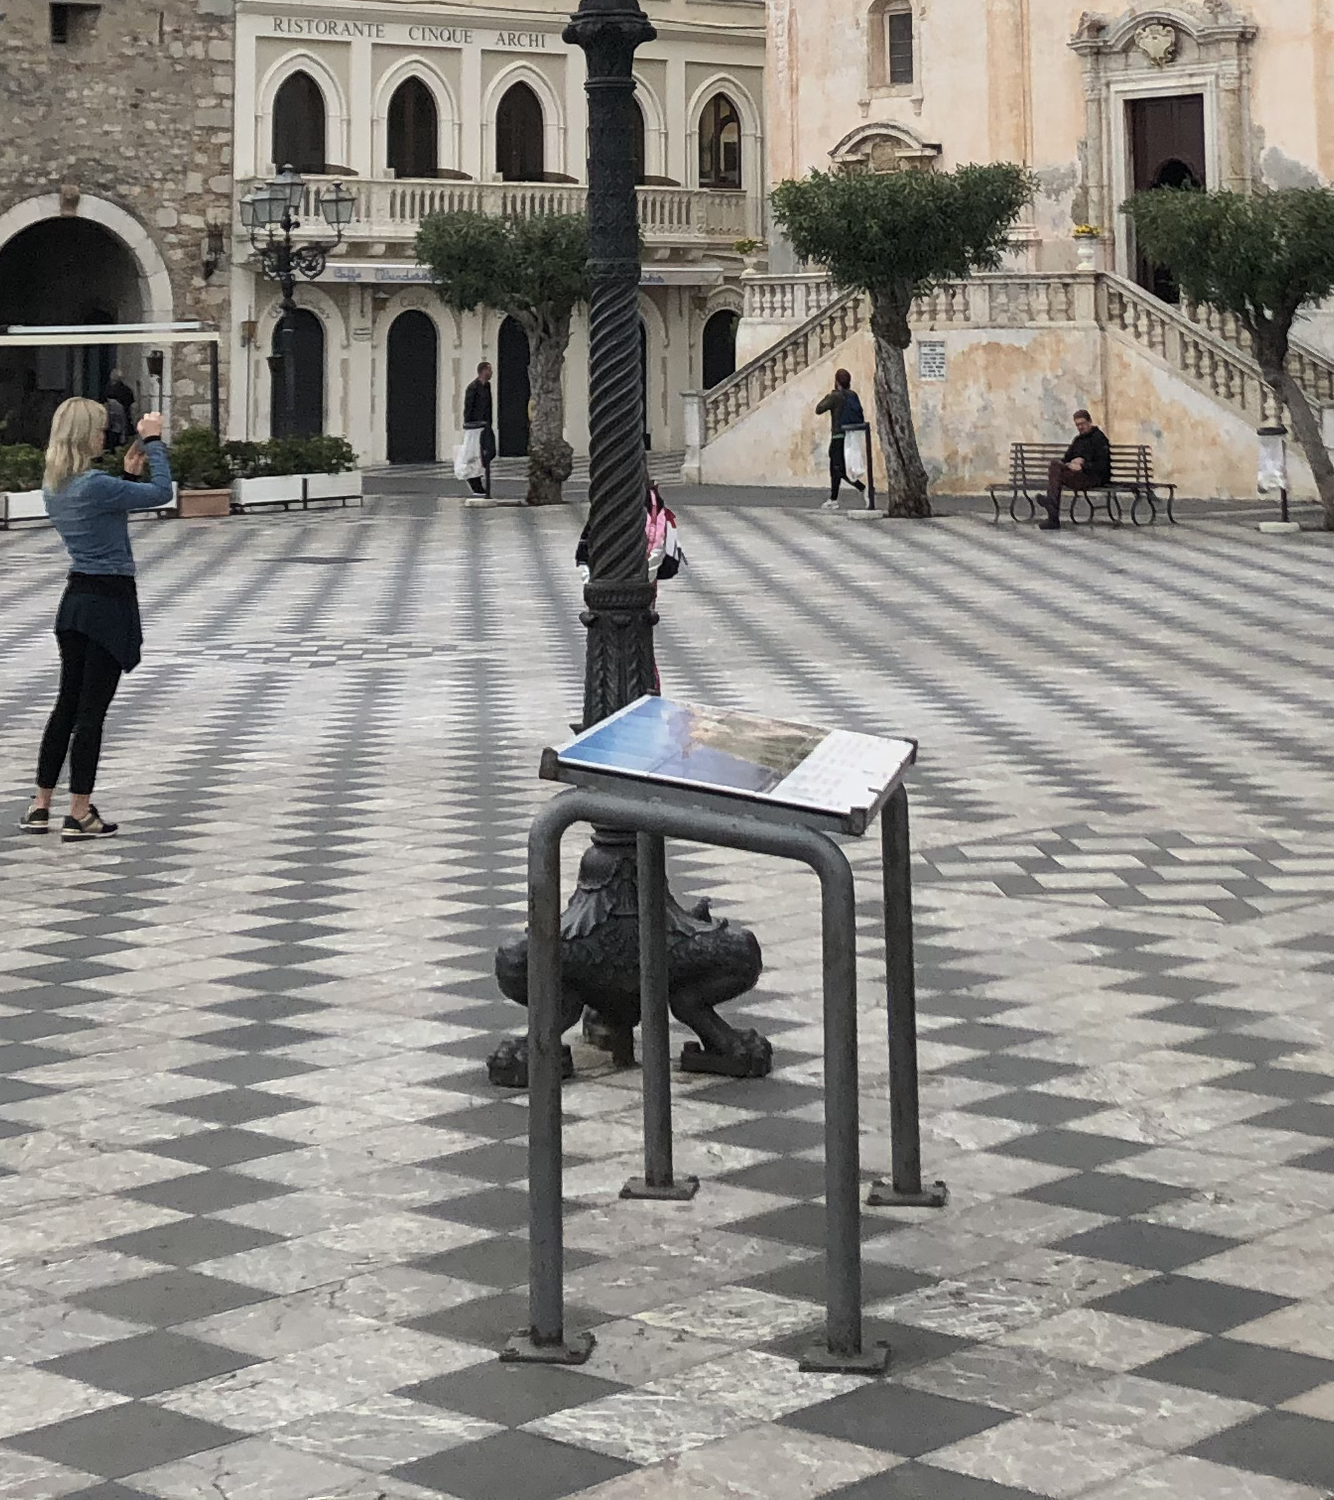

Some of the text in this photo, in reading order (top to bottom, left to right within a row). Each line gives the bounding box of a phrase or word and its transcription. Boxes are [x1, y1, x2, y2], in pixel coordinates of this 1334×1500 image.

[272, 17, 546, 48] RISTORANTE CINQUE ARCHI
